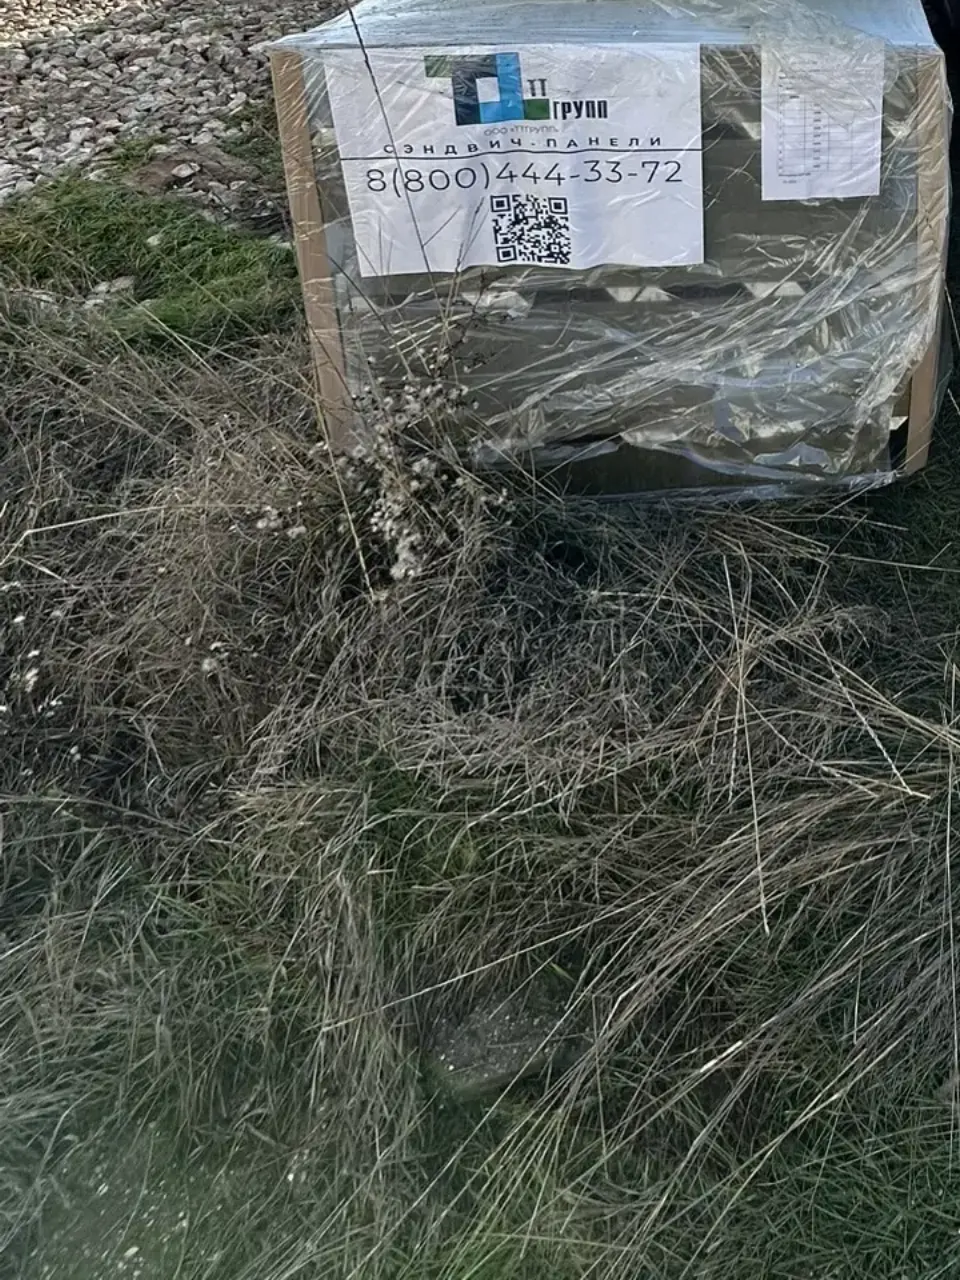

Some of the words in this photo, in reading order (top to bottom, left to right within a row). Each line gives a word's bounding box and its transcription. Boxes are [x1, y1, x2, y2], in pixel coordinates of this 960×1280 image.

[527, 78, 547, 97] ТТ
[552, 99, 609, 120] ГРУПП
[366, 159, 683, 198] 8(800)444-33-72
